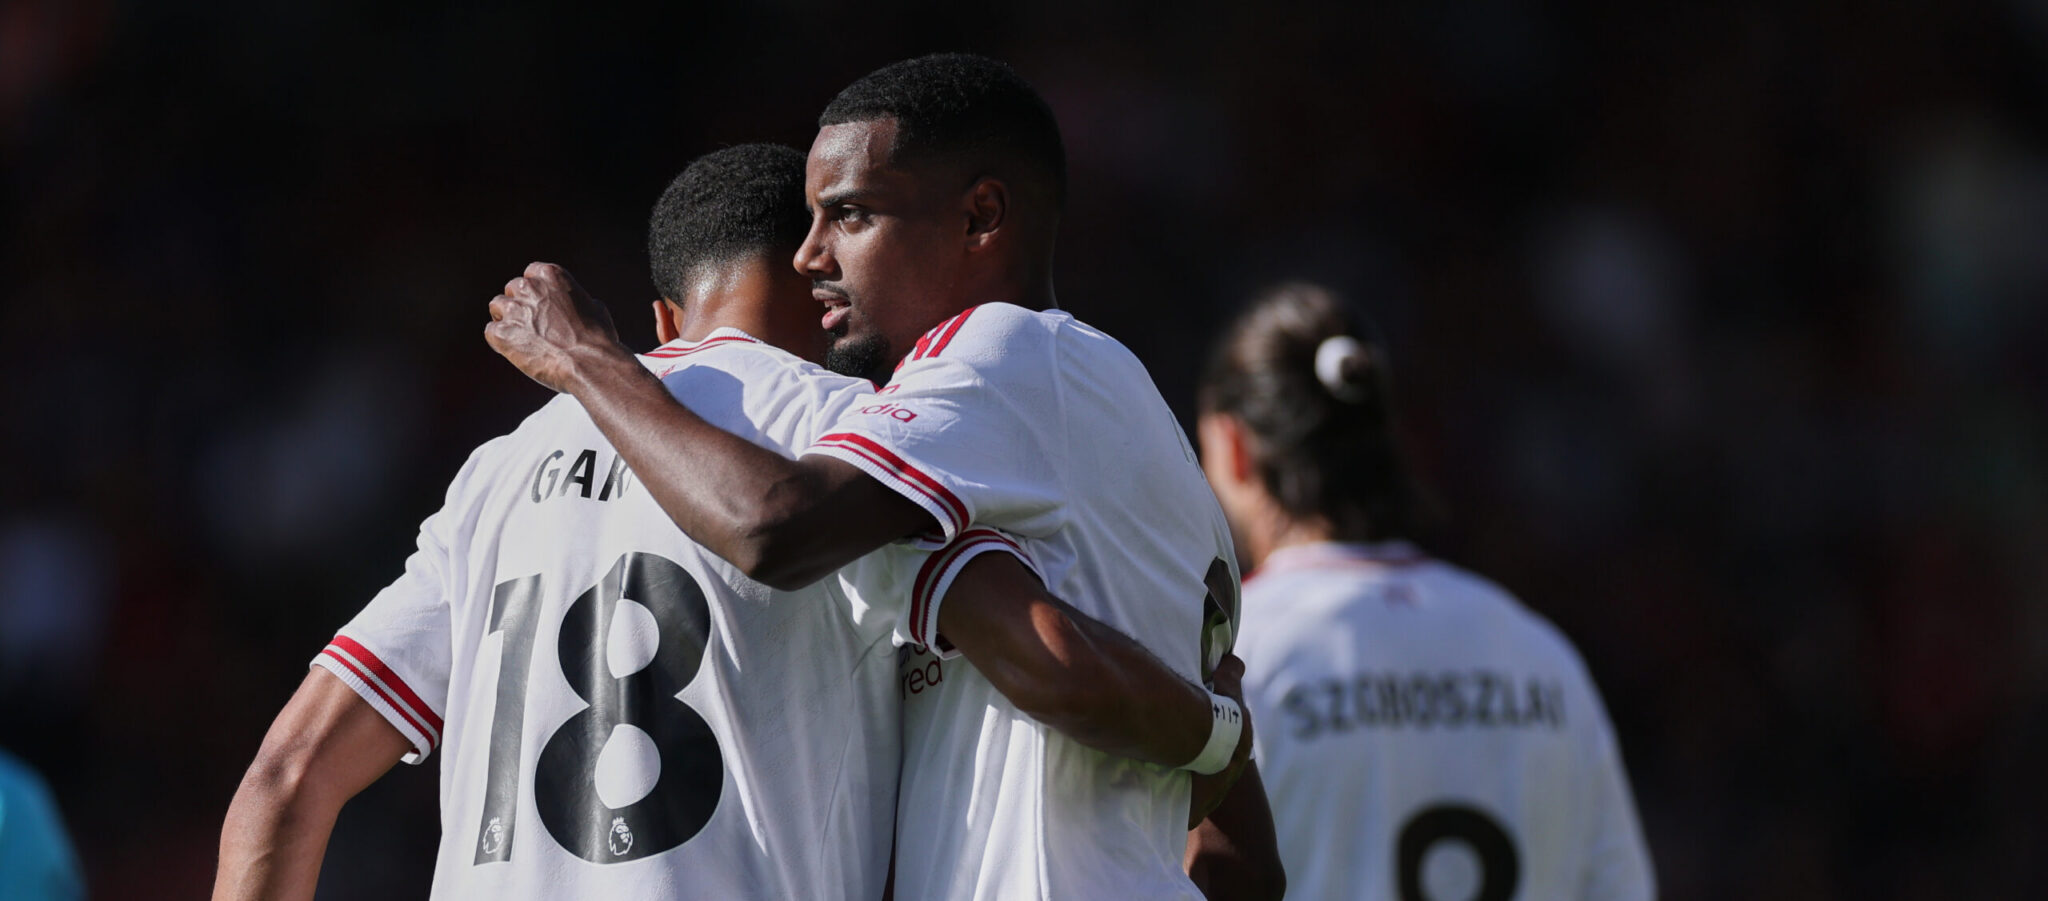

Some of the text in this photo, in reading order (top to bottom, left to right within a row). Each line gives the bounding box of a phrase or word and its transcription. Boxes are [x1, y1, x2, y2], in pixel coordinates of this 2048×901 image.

[857, 403, 918, 423] dia
[531, 449, 633, 503] GAK
[473, 551, 724, 866] 18
